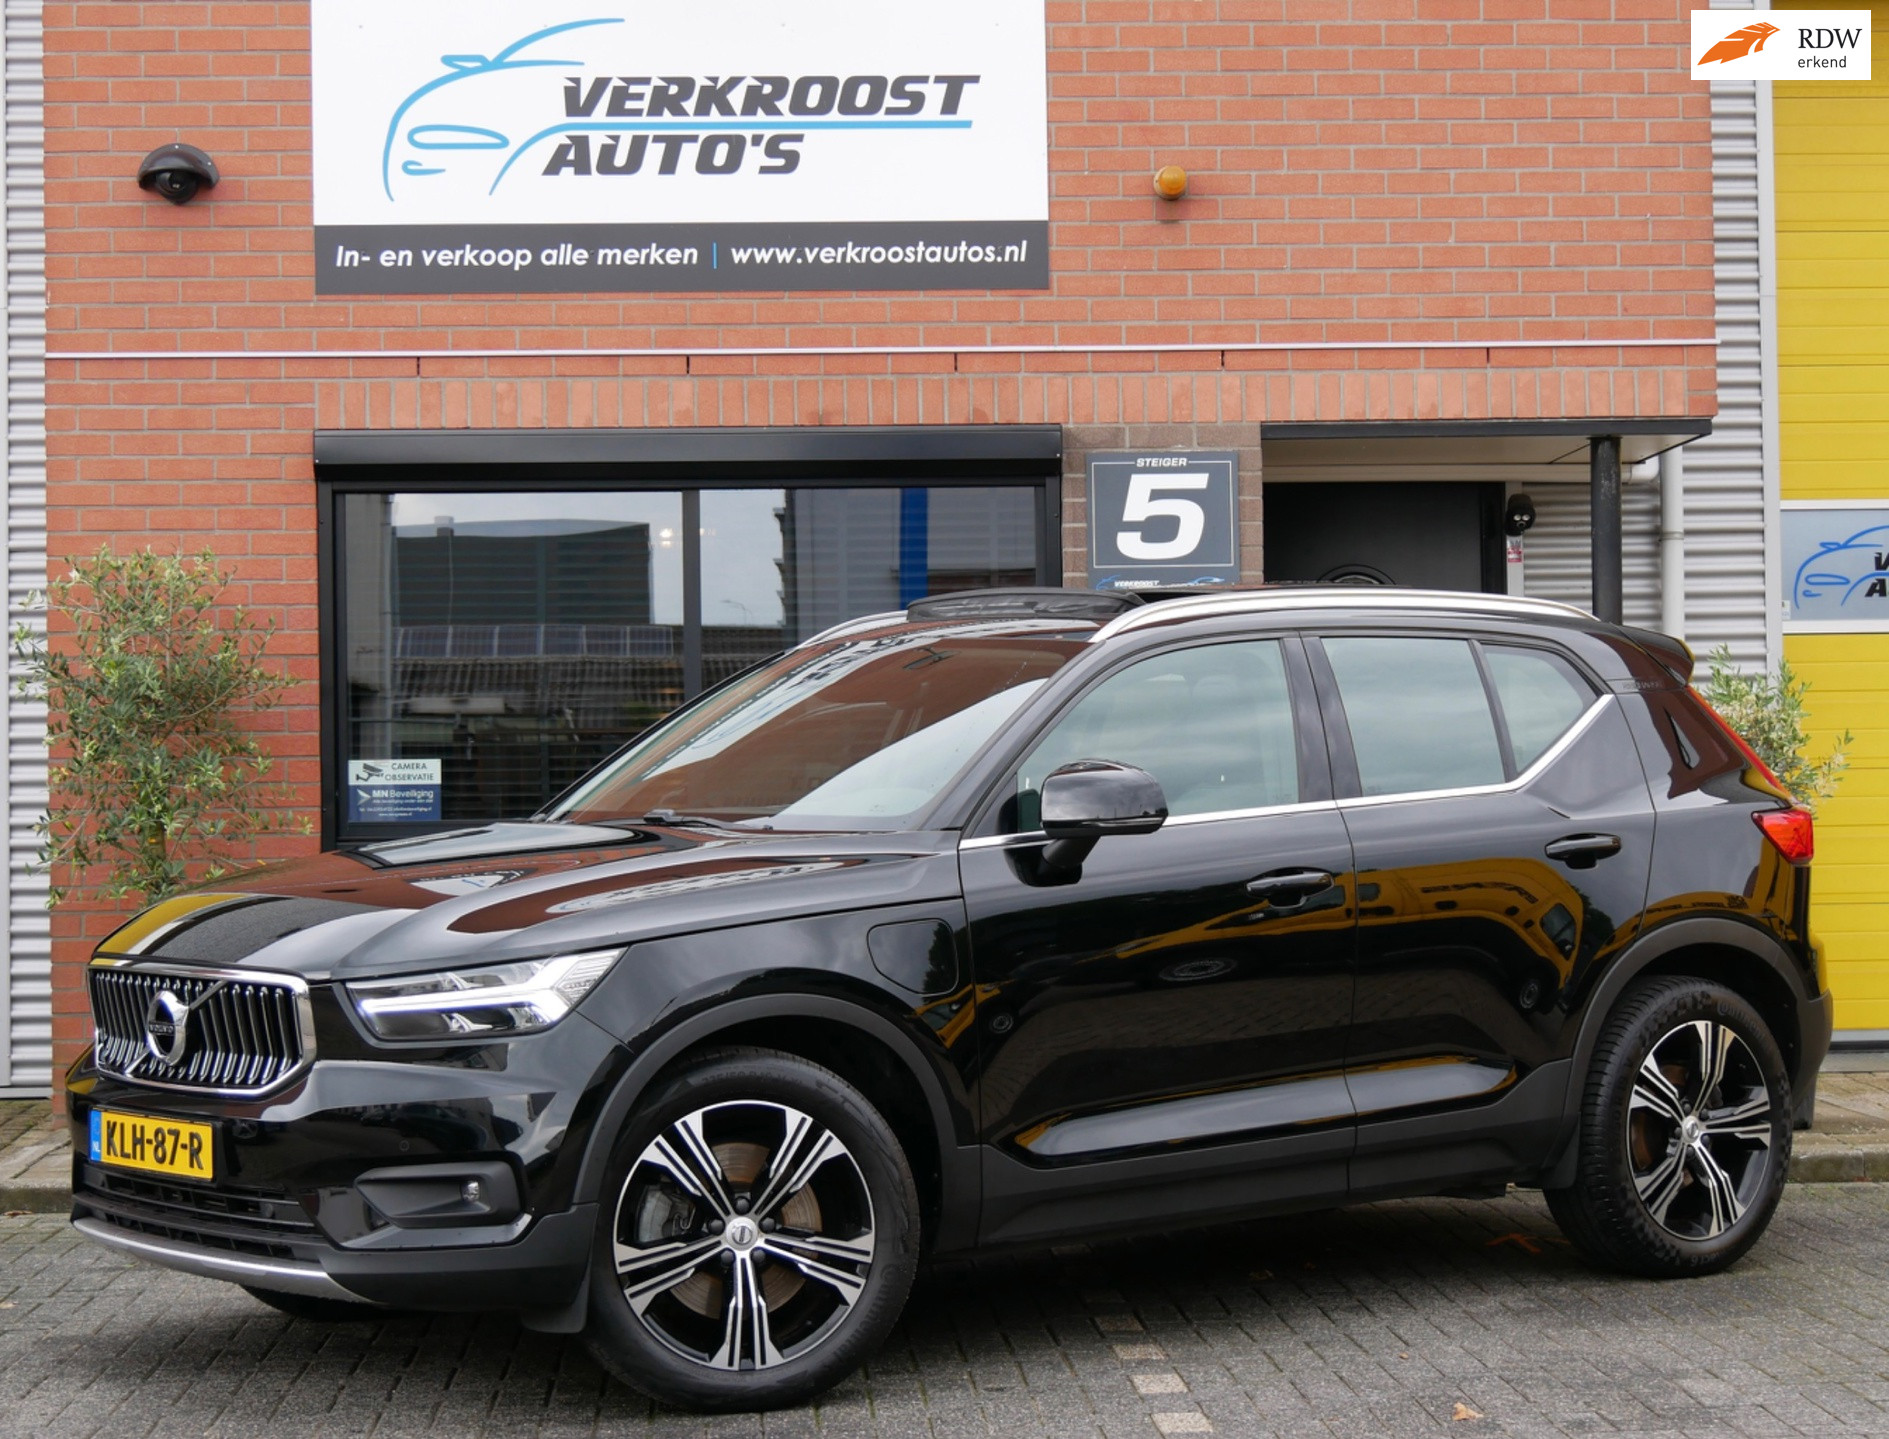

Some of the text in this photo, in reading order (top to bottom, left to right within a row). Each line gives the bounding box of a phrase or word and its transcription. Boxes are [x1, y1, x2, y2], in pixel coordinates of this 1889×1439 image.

[562, 74, 981, 118] VERKROOST
[541, 133, 805, 177] AUTO'S
[335, 240, 1028, 271] In- en verkoop alle merken www.verkroostautos.nl
[1136, 457, 1188, 468] STEIGER
[1116, 473, 1210, 561] 5
[372, 789, 434, 799] MN Beveiliging
[384, 773, 434, 781] OBSERVATIE
[106, 1120, 204, 1170] KLH-87-R
